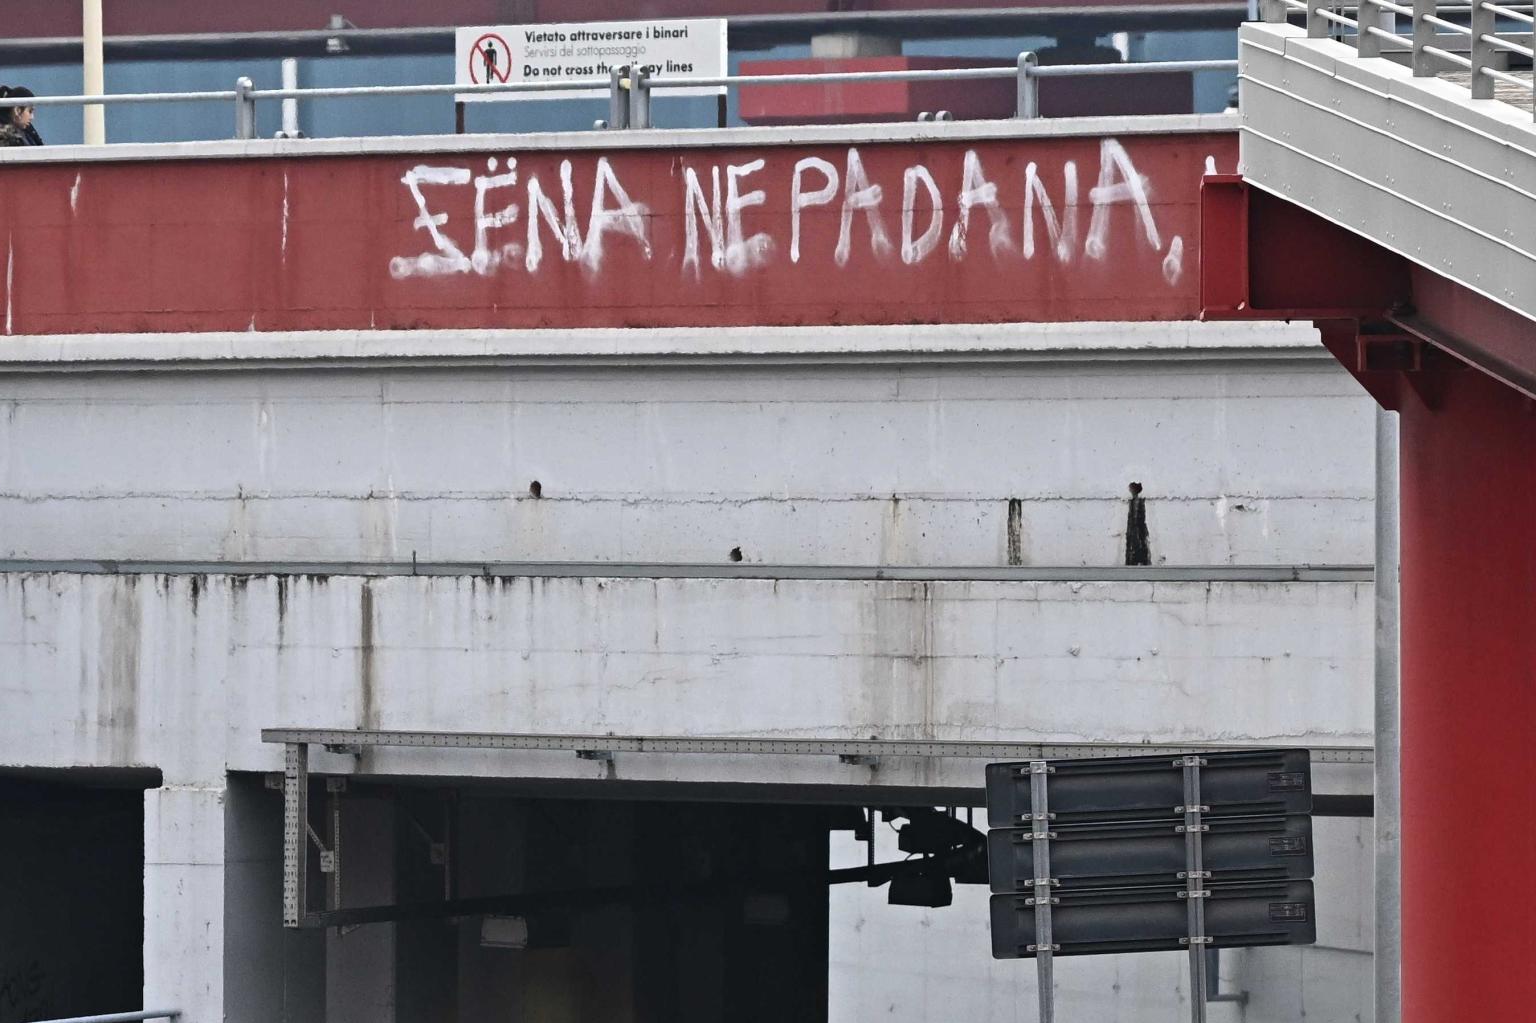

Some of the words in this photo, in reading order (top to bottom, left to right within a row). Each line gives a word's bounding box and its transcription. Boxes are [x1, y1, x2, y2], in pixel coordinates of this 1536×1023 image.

[524, 30, 566, 43] Vietato
[569, 30, 643, 42] attraversare
[646, 26, 650, 39] i
[653, 25, 689, 39] binari
[559, 44, 574, 57] del
[576, 43, 646, 58] sottopassaggio
[523, 64, 540, 77] Do
[543, 64, 562, 76] not
[565, 65, 594, 76] cross
[666, 59, 693, 73] lines
